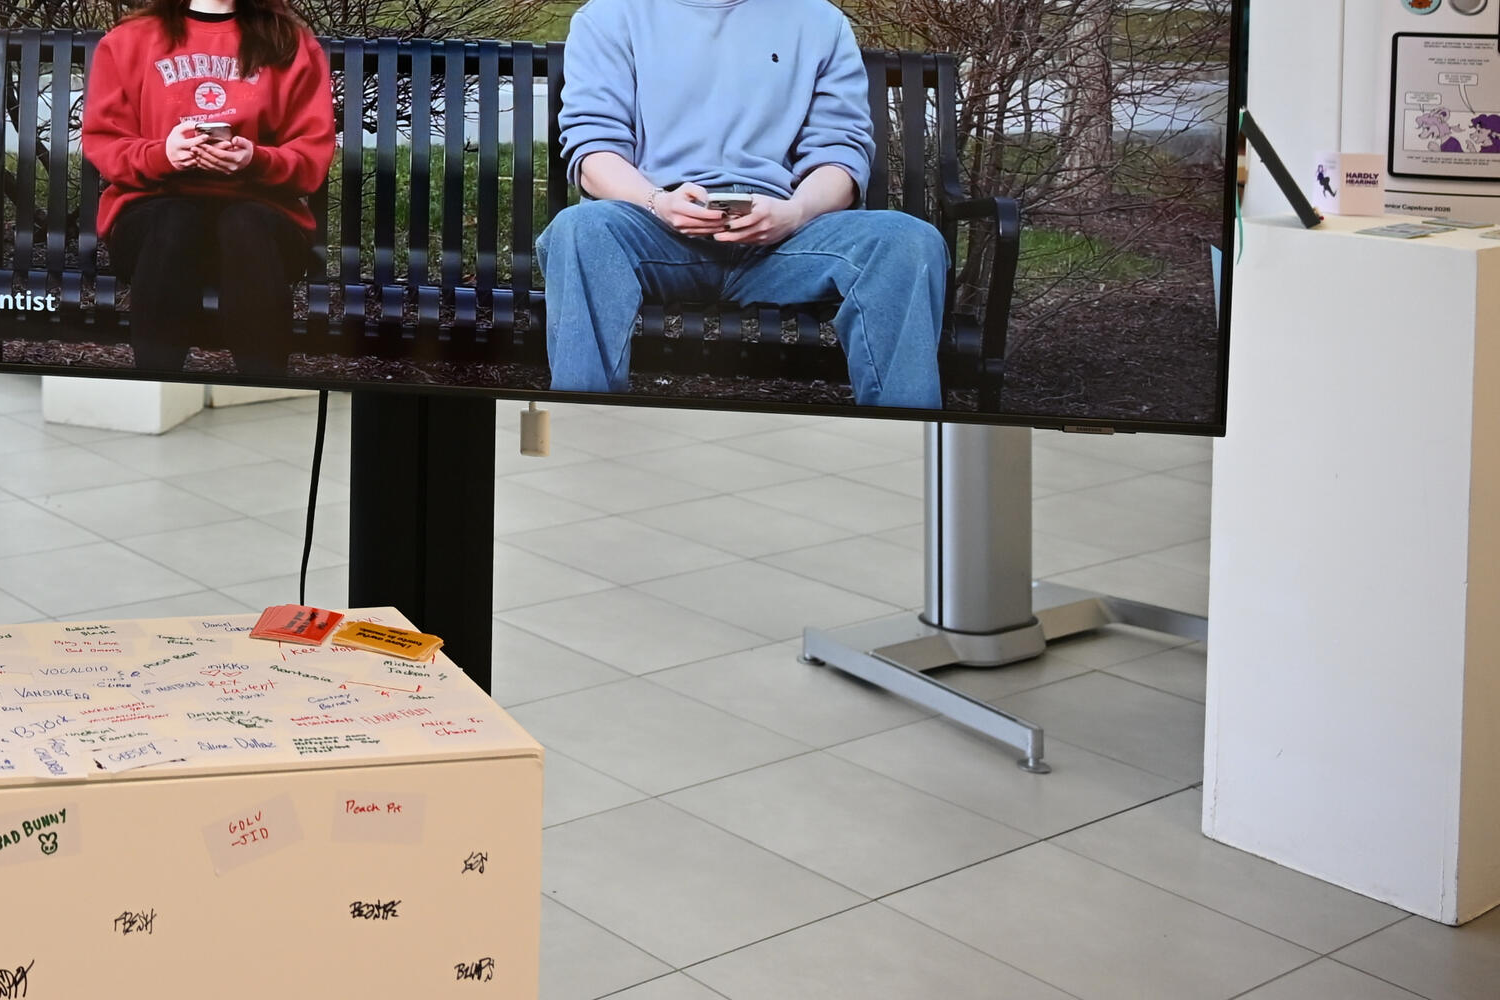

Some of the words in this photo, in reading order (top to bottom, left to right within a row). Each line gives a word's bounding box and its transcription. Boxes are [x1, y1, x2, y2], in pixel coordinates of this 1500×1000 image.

[1346, 172, 1379, 180] HARDLY
[1402, 203, 1433, 212] Capstone
[346, 800, 381, 815] Peach
[22, 808, 68, 838] BUNNY
